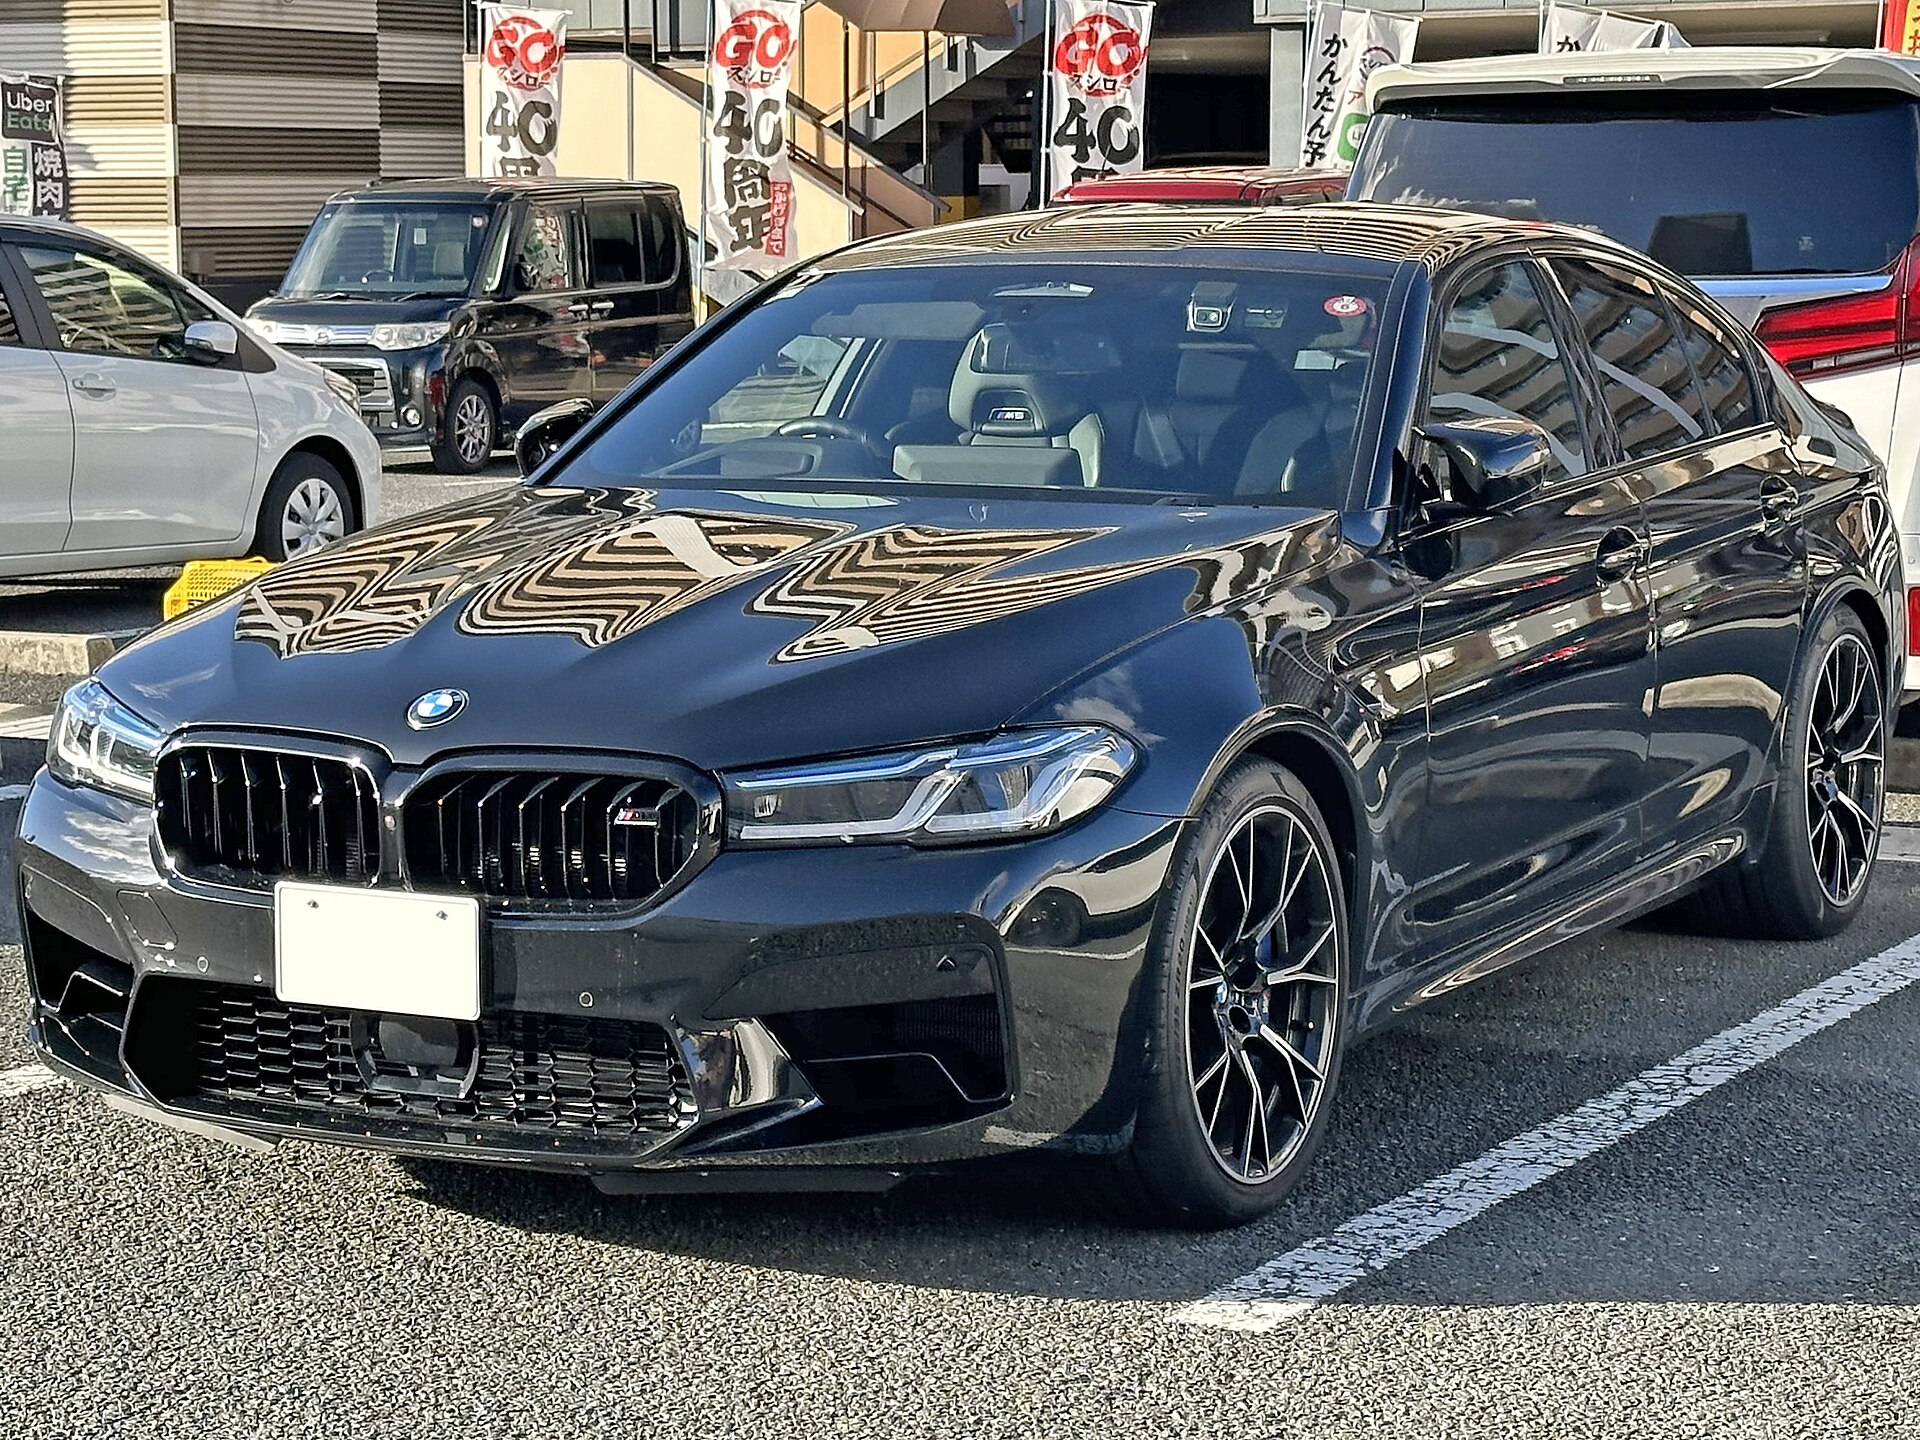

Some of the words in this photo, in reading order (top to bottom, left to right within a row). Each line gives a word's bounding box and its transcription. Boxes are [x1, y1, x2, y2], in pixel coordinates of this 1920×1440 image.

[1069, 74, 1131, 91] スシロー
[6, 91, 53, 113] Uber
[1303, 33, 1348, 167] かんたん予
[7, 110, 53, 132] Eats
